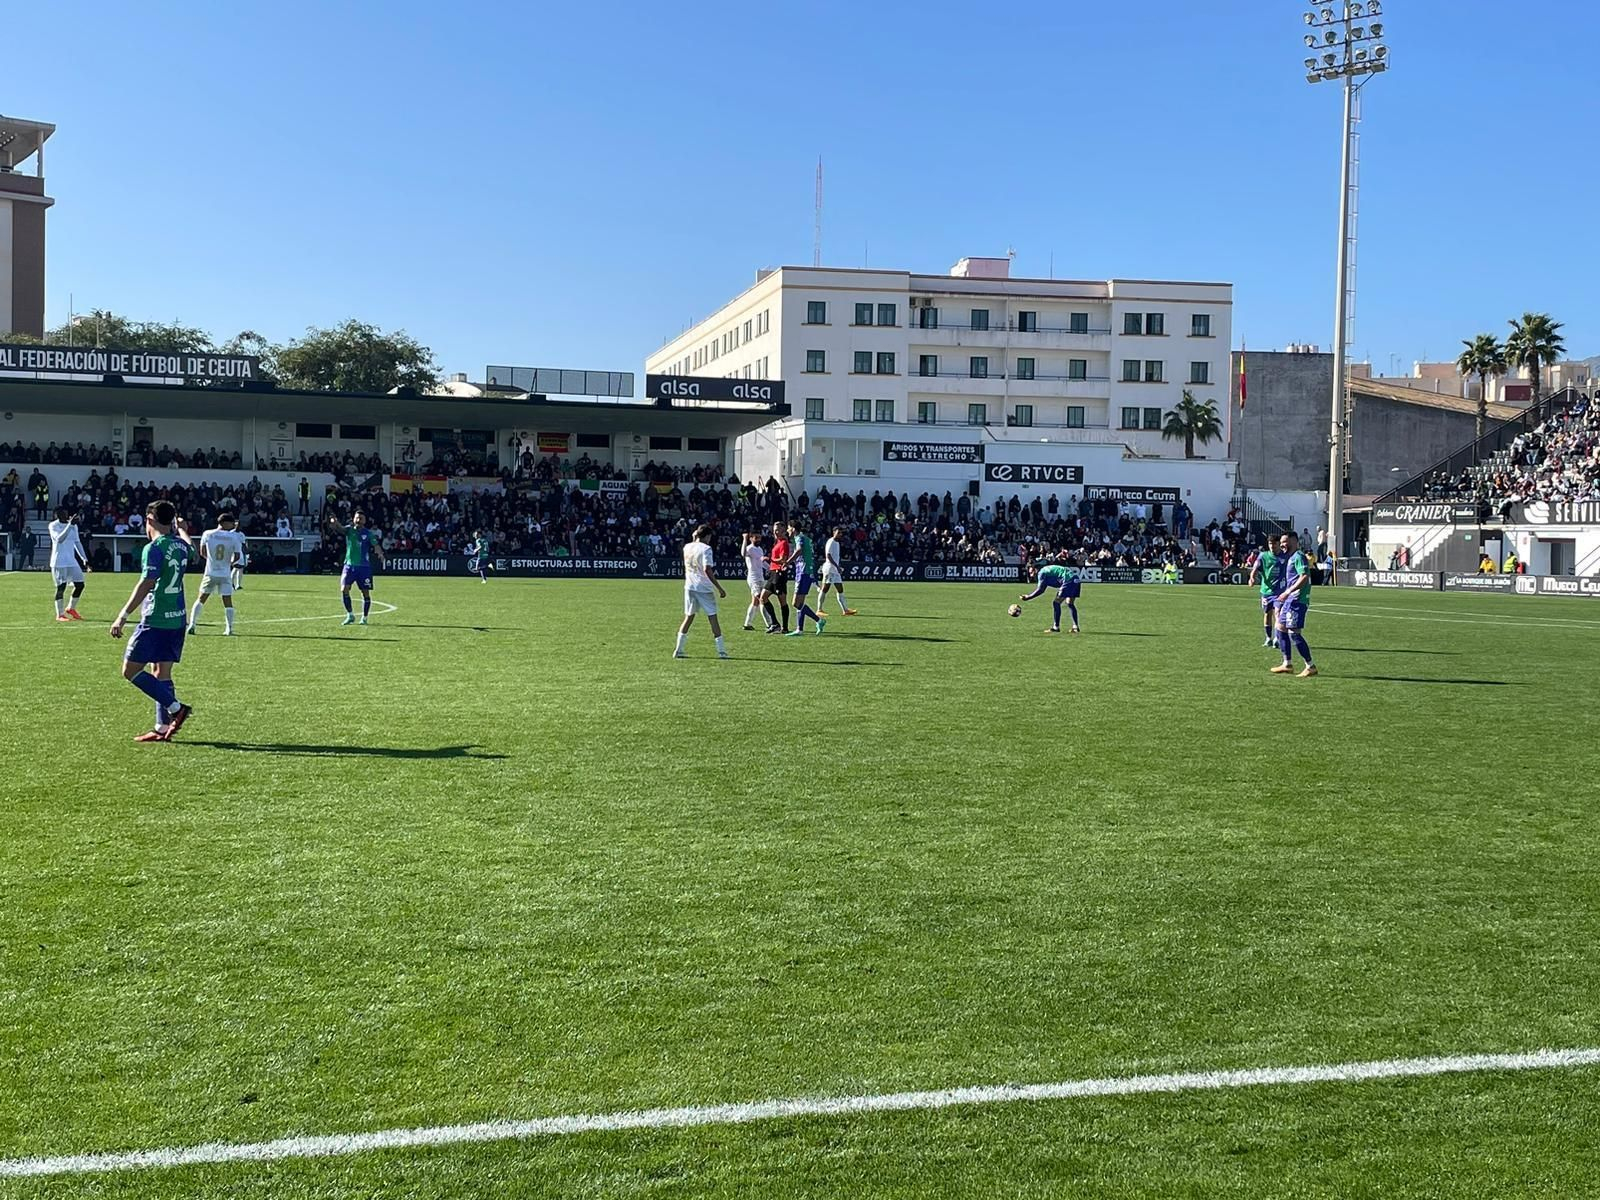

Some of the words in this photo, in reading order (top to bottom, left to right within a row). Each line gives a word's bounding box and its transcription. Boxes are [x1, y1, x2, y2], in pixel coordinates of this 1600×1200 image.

[0, 349, 16, 367] AL
[19, 349, 107, 371] FEDERACIÓN
[111, 354, 129, 372] DE
[132, 352, 185, 374] FÚTBOL
[187, 357, 205, 376] DE
[209, 359, 252, 378] CEUTA
[660, 379, 700, 396] alsa
[732, 383, 771, 399] alsa
[925, 445, 975, 453] TRANSPORTES
[921, 452, 967, 460] ESTRECHO
[1021, 466, 1075, 481] RTVCE
[1395, 505, 1452, 523] GRANIER
[392, 557, 447, 571] FEDERACIÓN
[511, 560, 573, 568] ESTRUCTURAS
[575, 560, 591, 568] DEL
[593, 560, 638, 569] ESTRECHO
[850, 565, 914, 575] SOLANO
[946, 565, 960, 577] EL
[962, 566, 1019, 578] MARCADOR
[1379, 572, 1434, 584] ELECTRICISTAS
